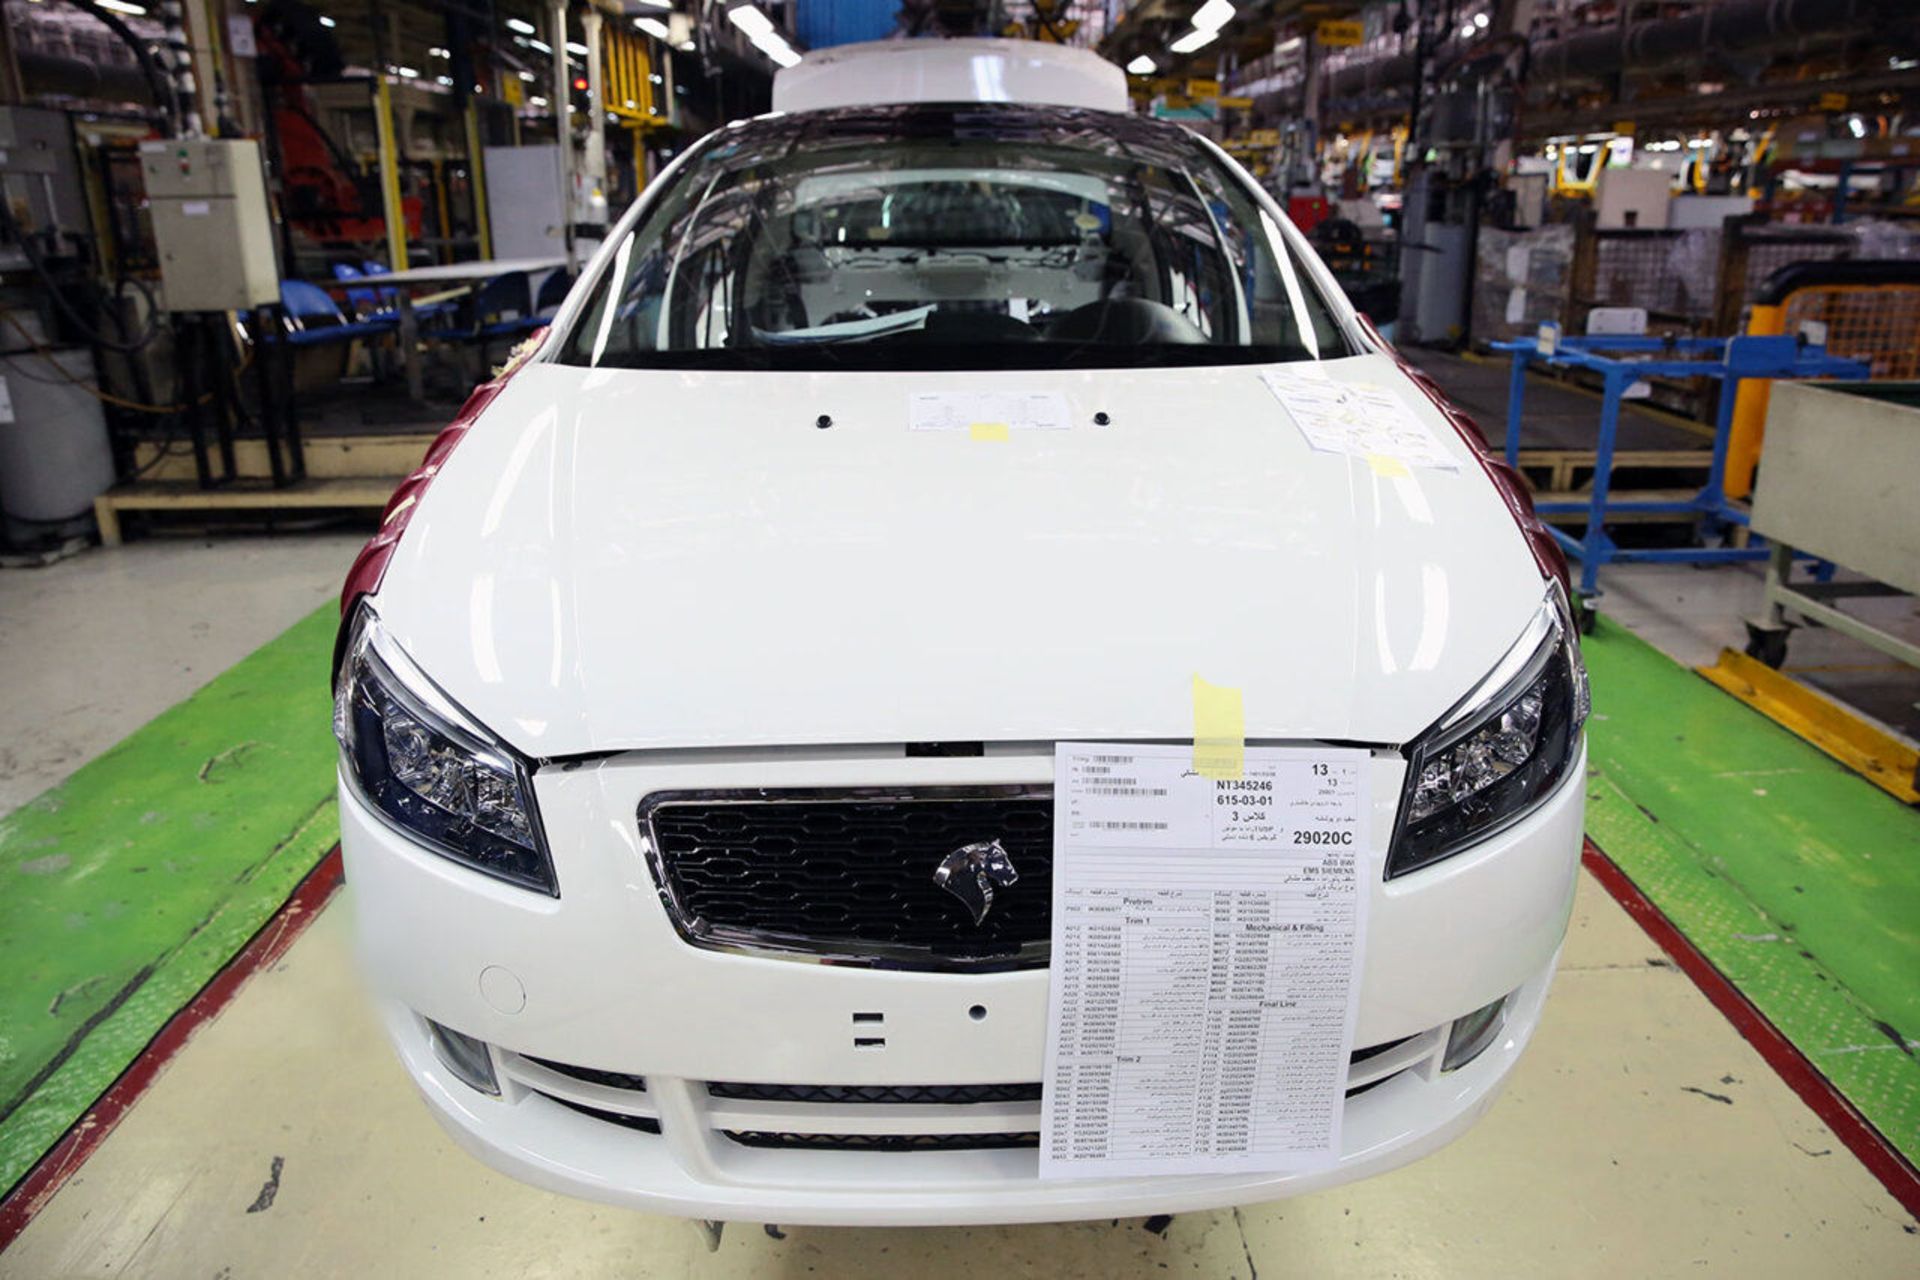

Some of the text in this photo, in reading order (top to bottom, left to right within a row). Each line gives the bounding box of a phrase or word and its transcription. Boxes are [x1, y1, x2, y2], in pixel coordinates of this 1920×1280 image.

[1312, 763, 1328, 776] 13
[1216, 780, 1273, 791] NT345246
[1327, 778, 1338, 787] 13
[1217, 795, 1273, 806] 615-03-01
[1232, 811, 1239, 822] 3
[1293, 830, 1353, 845] 29020C
[1246, 924, 1290, 932] Mechanical
[1292, 924, 1298, 932] &
